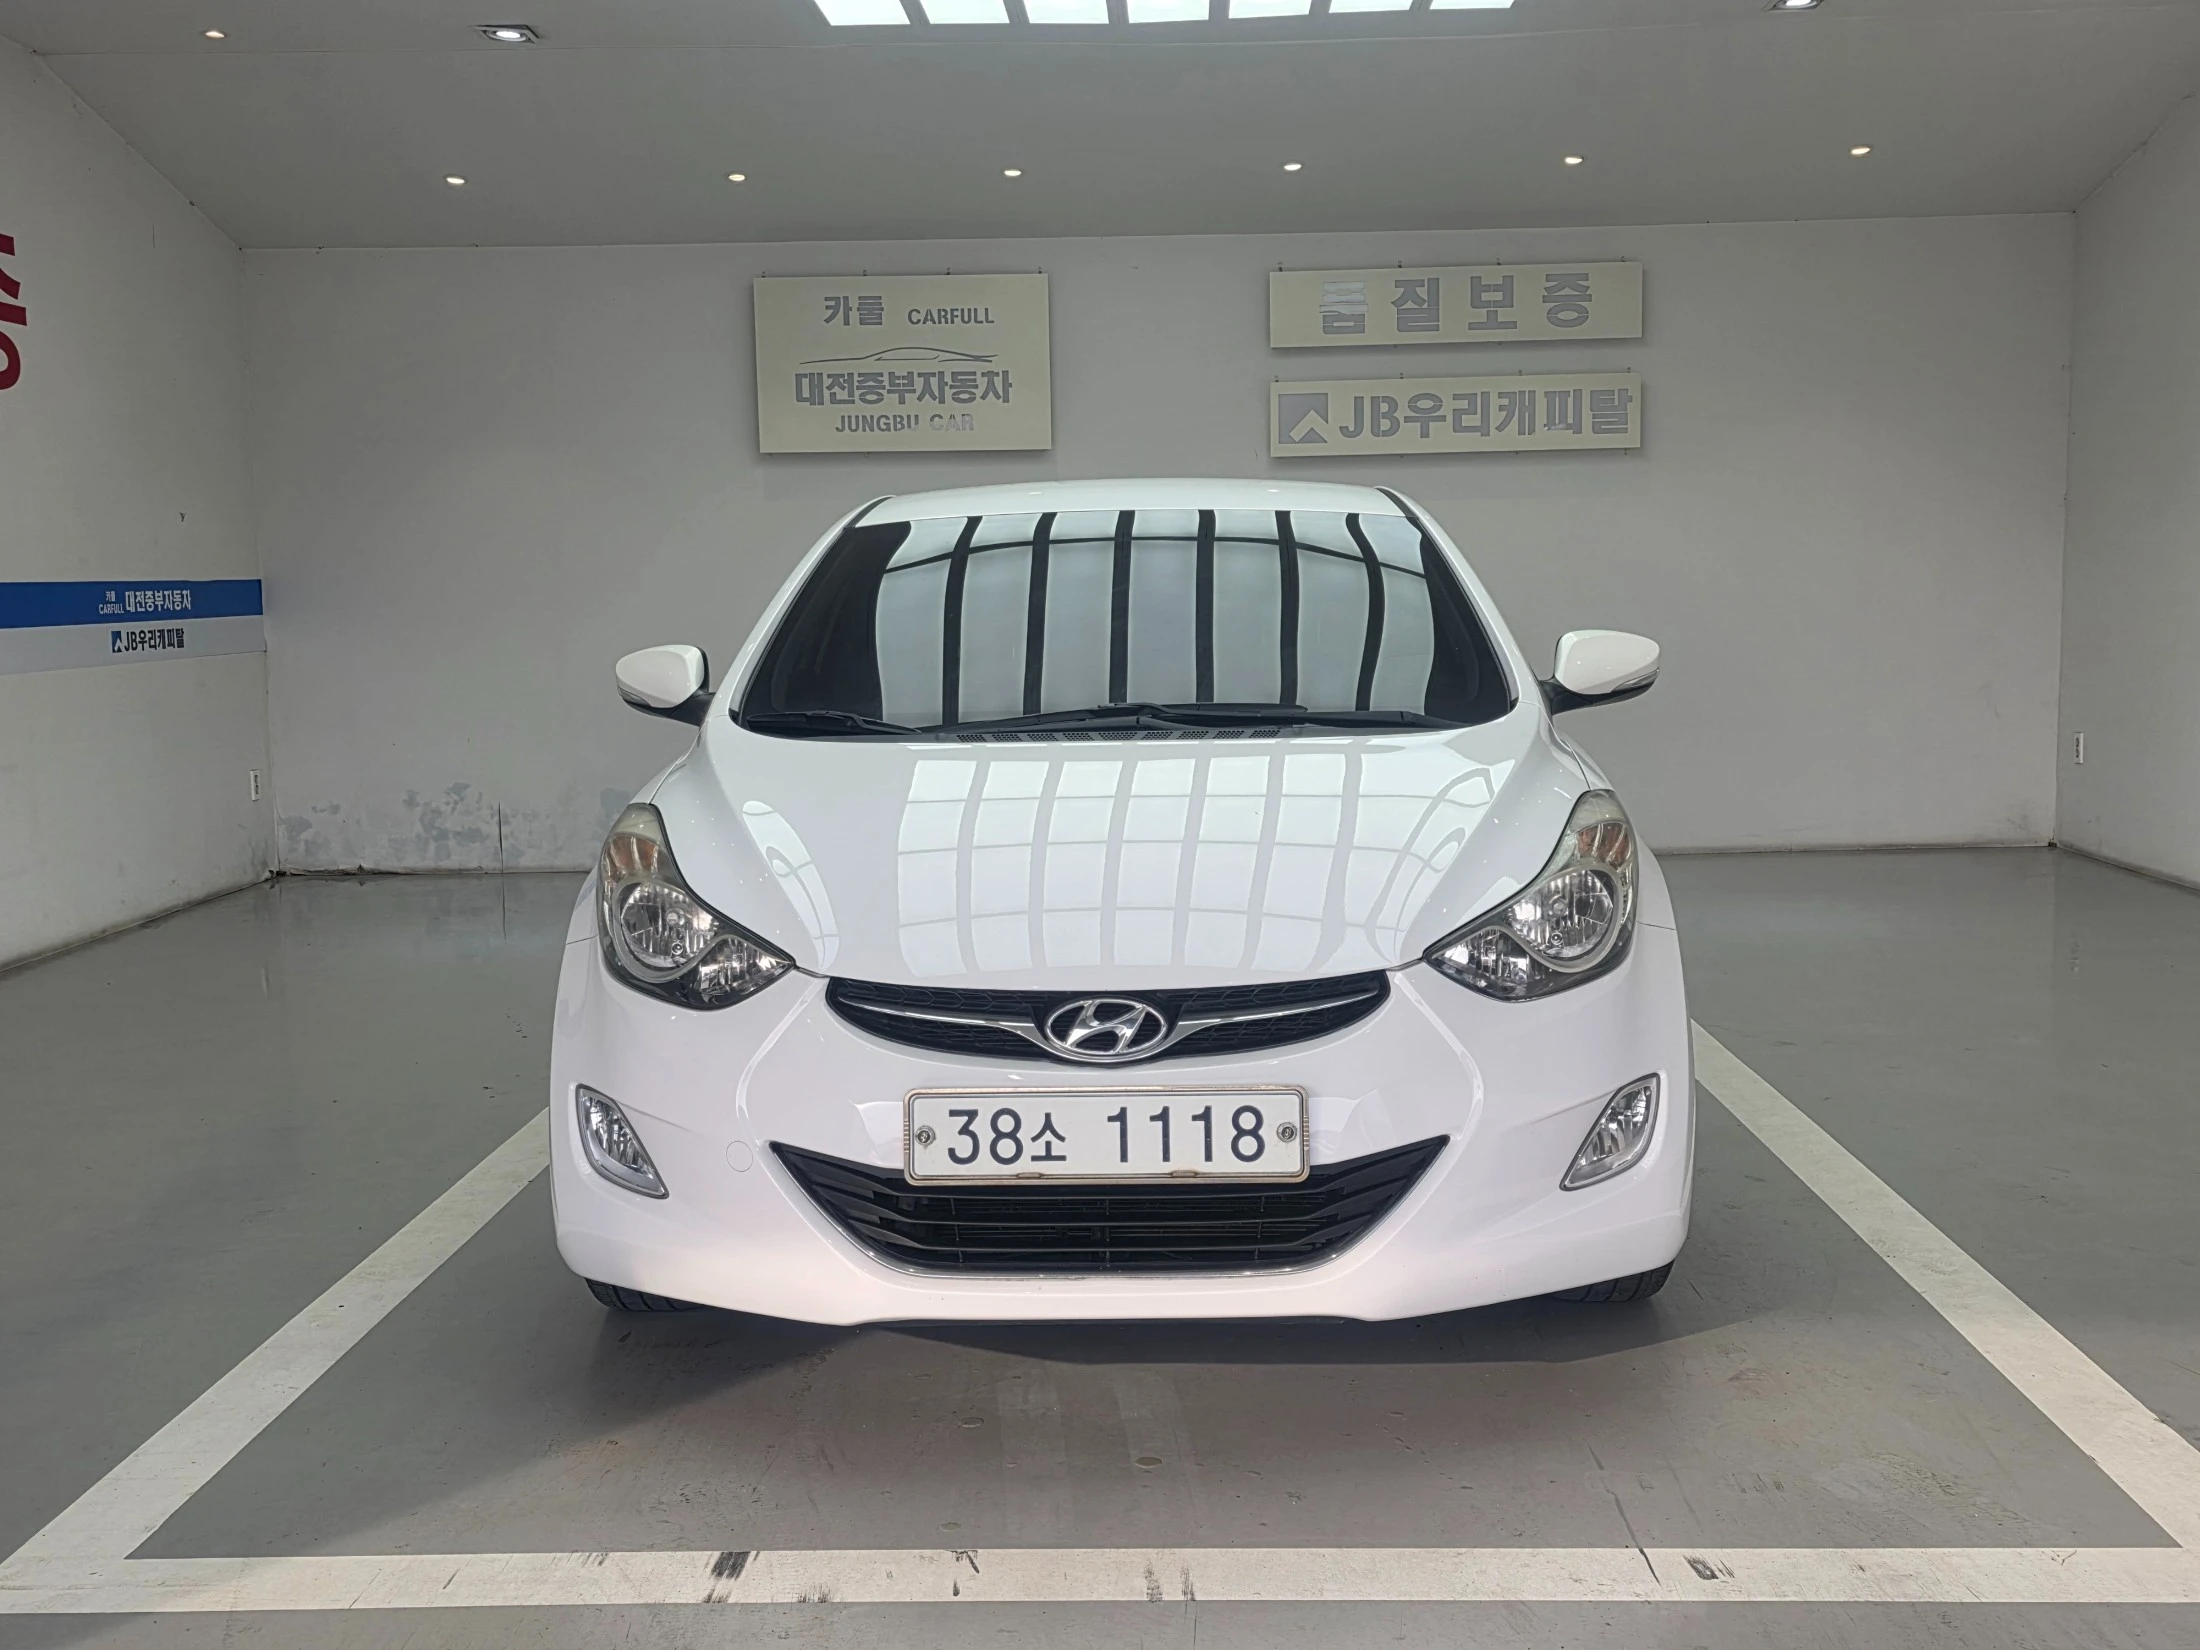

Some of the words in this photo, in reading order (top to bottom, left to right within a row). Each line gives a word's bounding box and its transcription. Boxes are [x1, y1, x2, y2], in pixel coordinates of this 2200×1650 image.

[907, 307, 995, 325] CARFULL
[794, 370, 1013, 406] 대전중부자동차
[835, 413, 920, 433] JUNGBU
[929, 413, 975, 432] CAR
[1338, 387, 1633, 439] JB우리캐피탈
[98, 603, 125, 614] CARFULL
[125, 589, 191, 613] 대전중부자동차
[123, 627, 185, 652] JB우리캐피탈
[947, 1107, 1068, 1166] 38소
[1106, 1104, 1266, 1164] 1118
